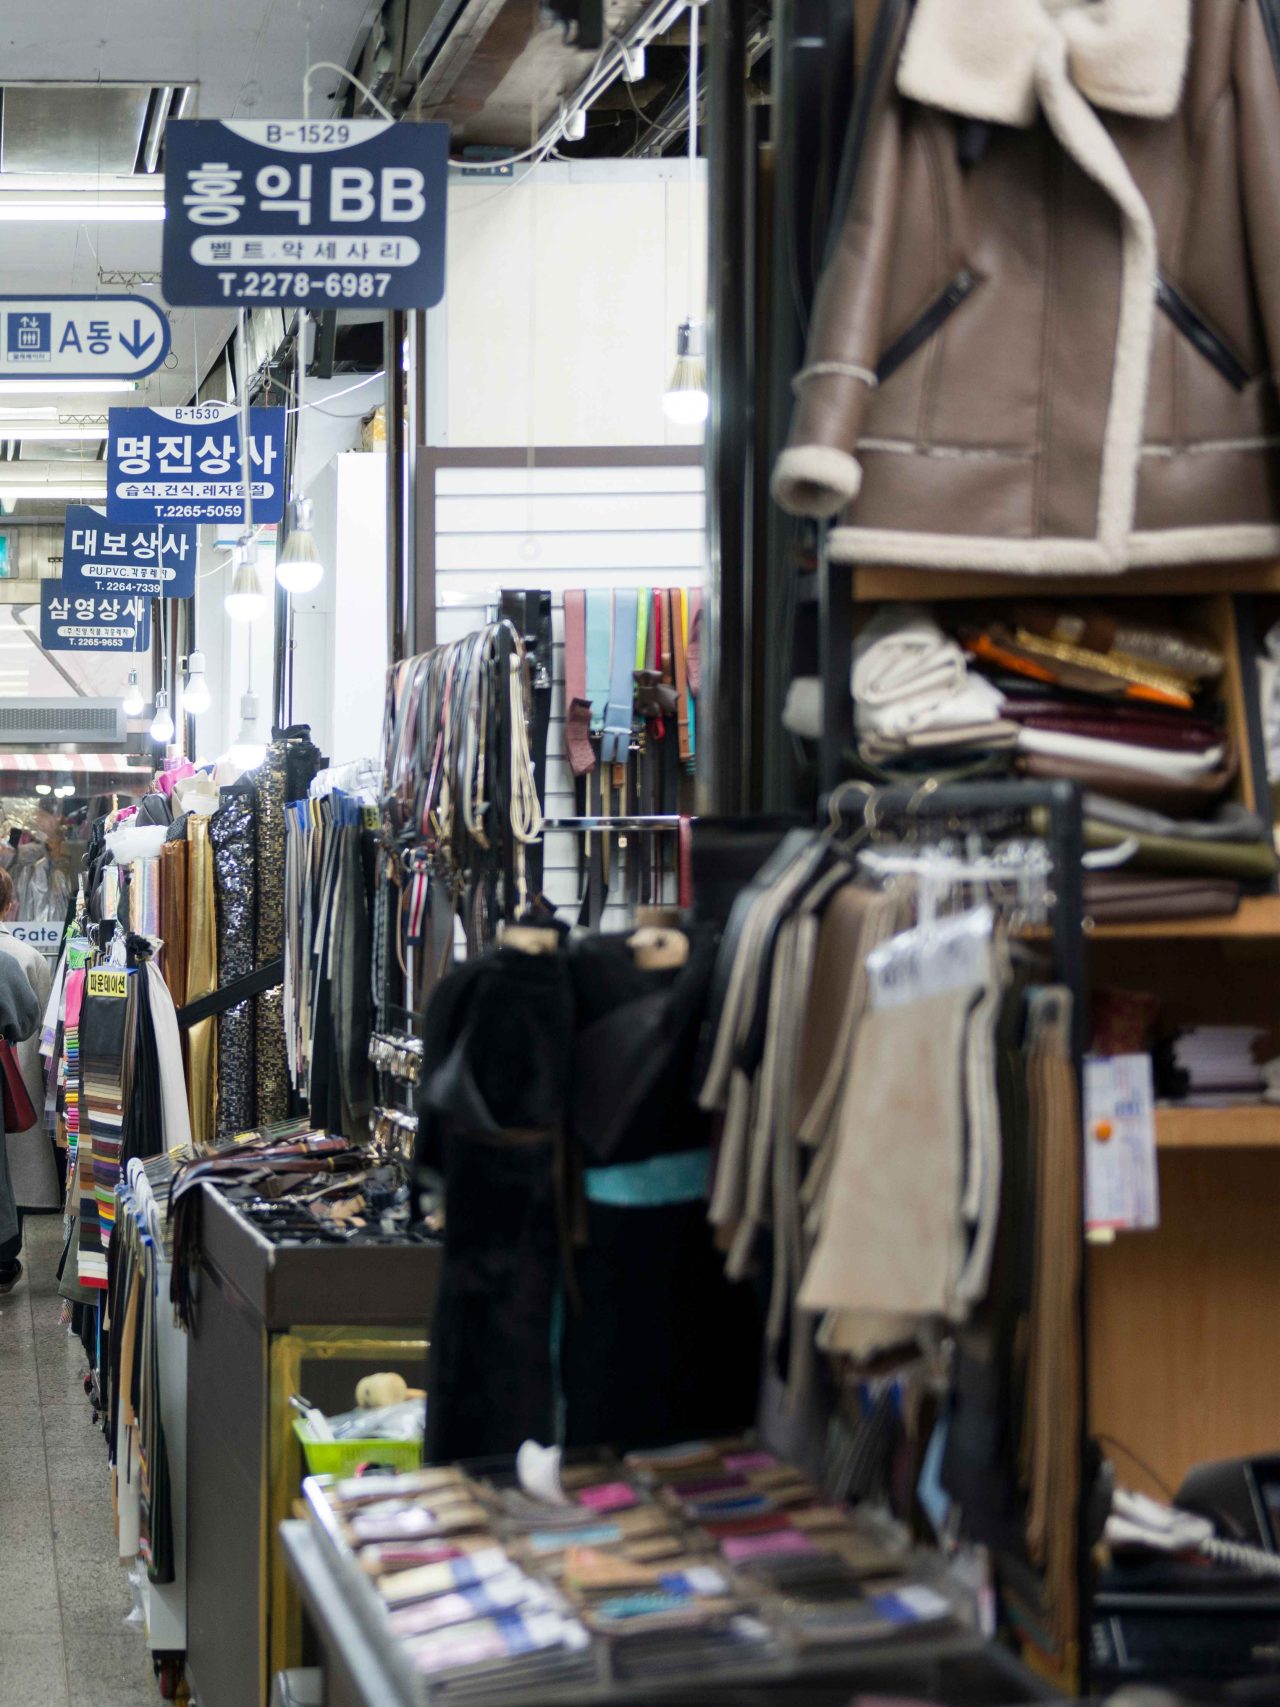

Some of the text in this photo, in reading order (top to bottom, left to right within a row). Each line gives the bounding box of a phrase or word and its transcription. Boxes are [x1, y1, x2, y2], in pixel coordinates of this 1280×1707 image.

[267, 125, 350, 144] B-1529
[183, 163, 426, 226] 홍익BB
[218, 272, 391, 297] T.2278-6987
[58, 321, 112, 355] A동
[175, 408, 219, 420] B-1530
[116, 435, 277, 474] 명진상사
[154, 505, 242, 517] T.2265-5059
[71, 529, 189, 561] 대보상사
[48, 597, 145, 621] 삼영상사
[12, 928, 58, 941] Gate
